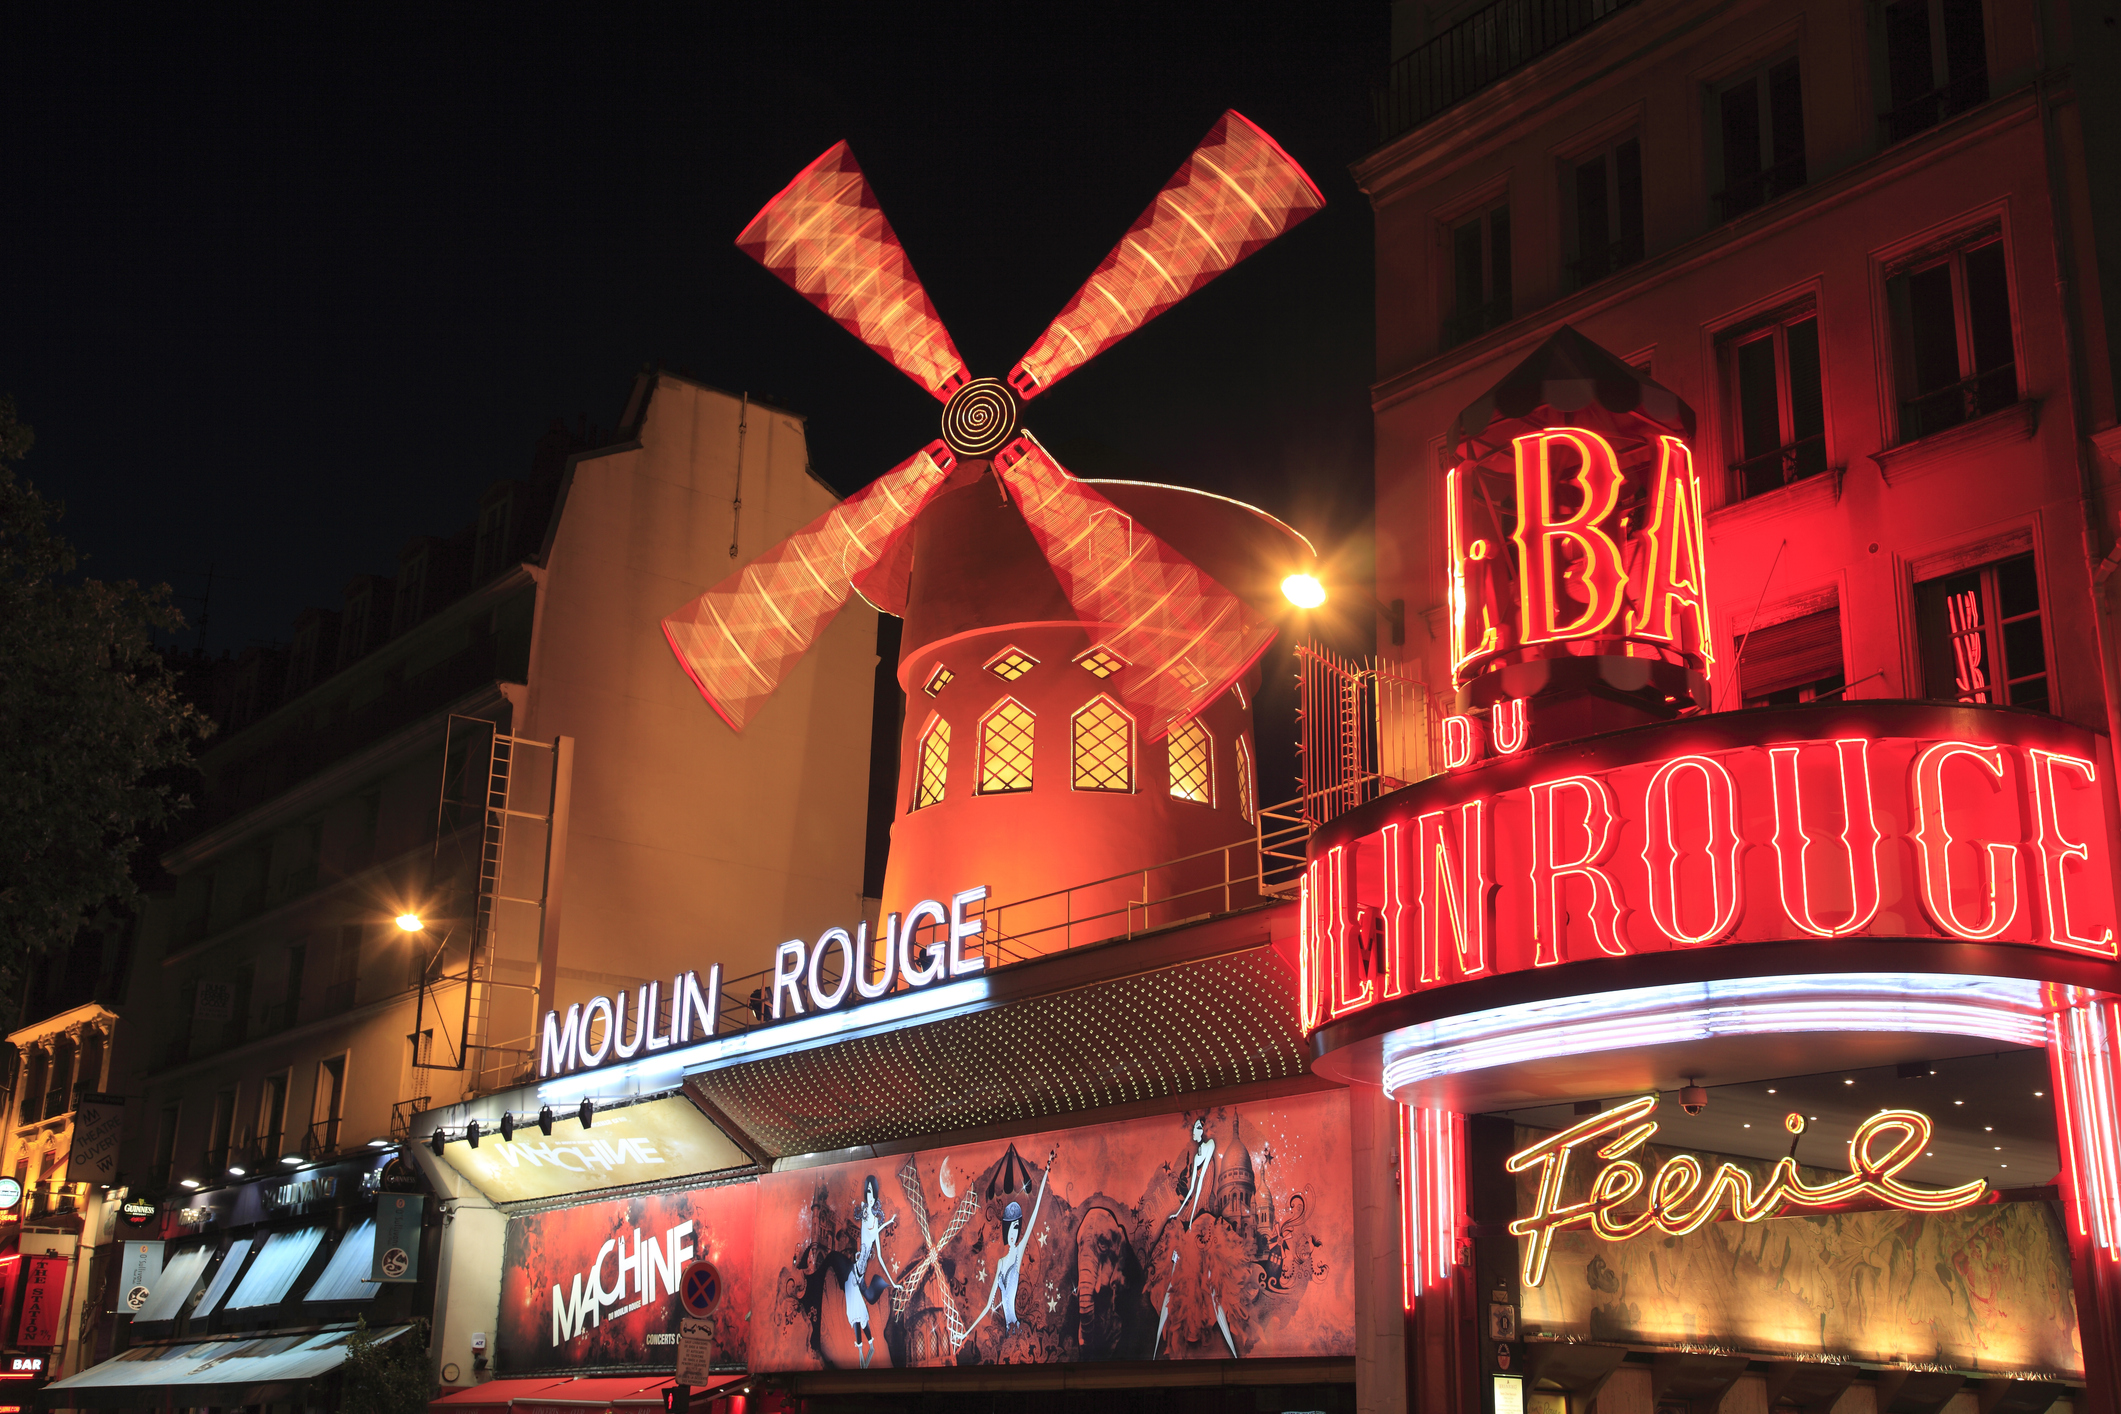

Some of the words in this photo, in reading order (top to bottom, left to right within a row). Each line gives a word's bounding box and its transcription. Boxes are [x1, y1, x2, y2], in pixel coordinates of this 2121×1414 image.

[1441, 698, 1526, 769] DU
[1529, 738, 2118, 967] ROUGE
[539, 962, 724, 1078] MOULIN
[771, 885, 992, 1020] ROUGE
[77, 1114, 122, 1148] THEATRE
[75, 1134, 119, 1165] OUVERT
[1506, 1094, 1990, 1288] Féerie
[124, 1203, 155, 1215] GUINNESS
[34, 1262, 48, 1284] THE
[24, 1288, 44, 1341] STATION
[646, 1333, 676, 1345] CONCERTS
[12, 1359, 42, 1371] BAR
